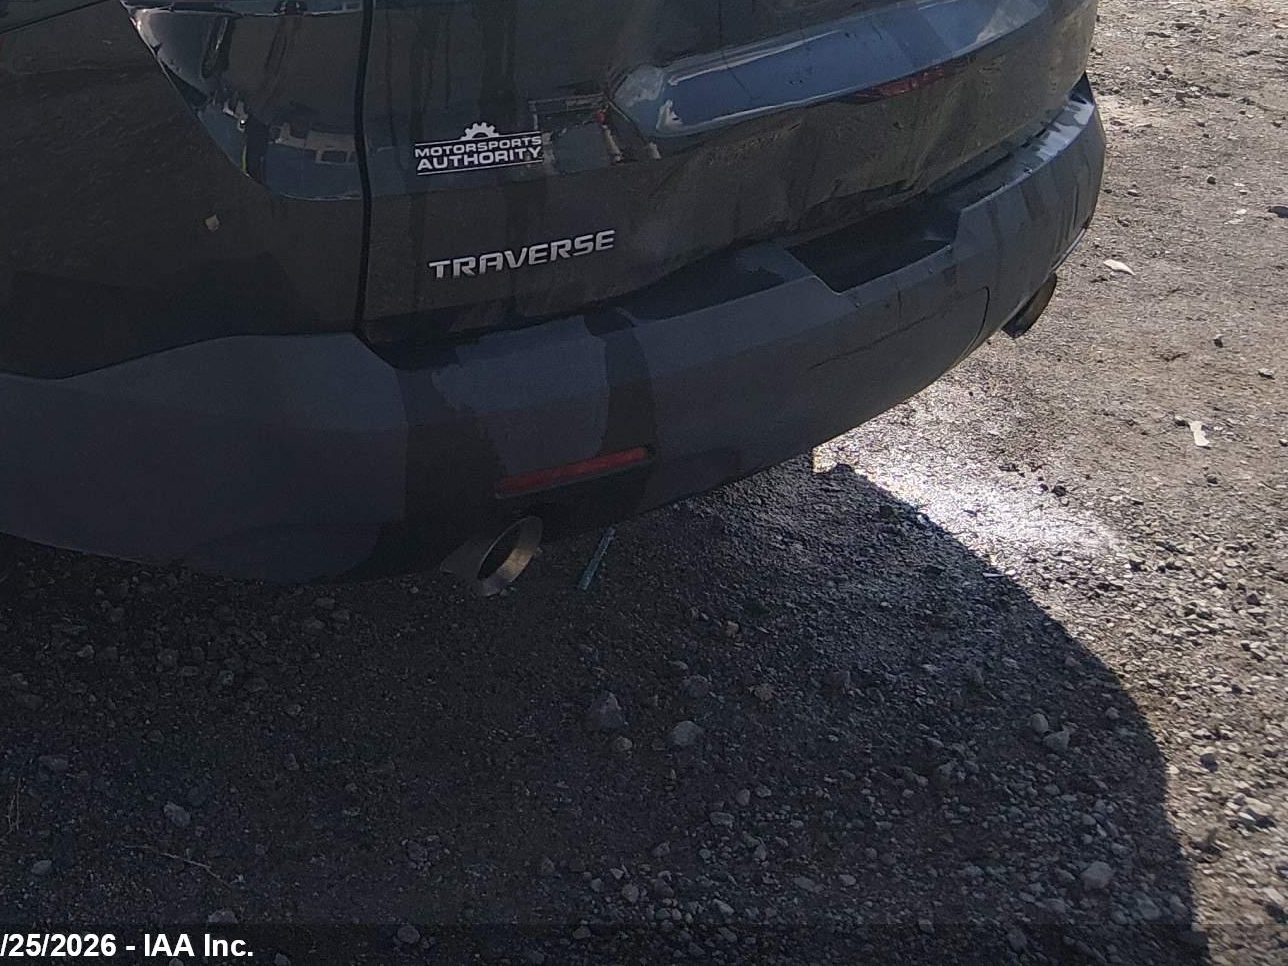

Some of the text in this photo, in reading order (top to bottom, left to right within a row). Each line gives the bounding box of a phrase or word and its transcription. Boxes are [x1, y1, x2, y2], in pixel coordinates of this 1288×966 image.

[414, 136, 542, 158] MOTORSPORTS
[416, 146, 542, 171] AUTHORITY
[428, 229, 616, 279] TRAVERSE
